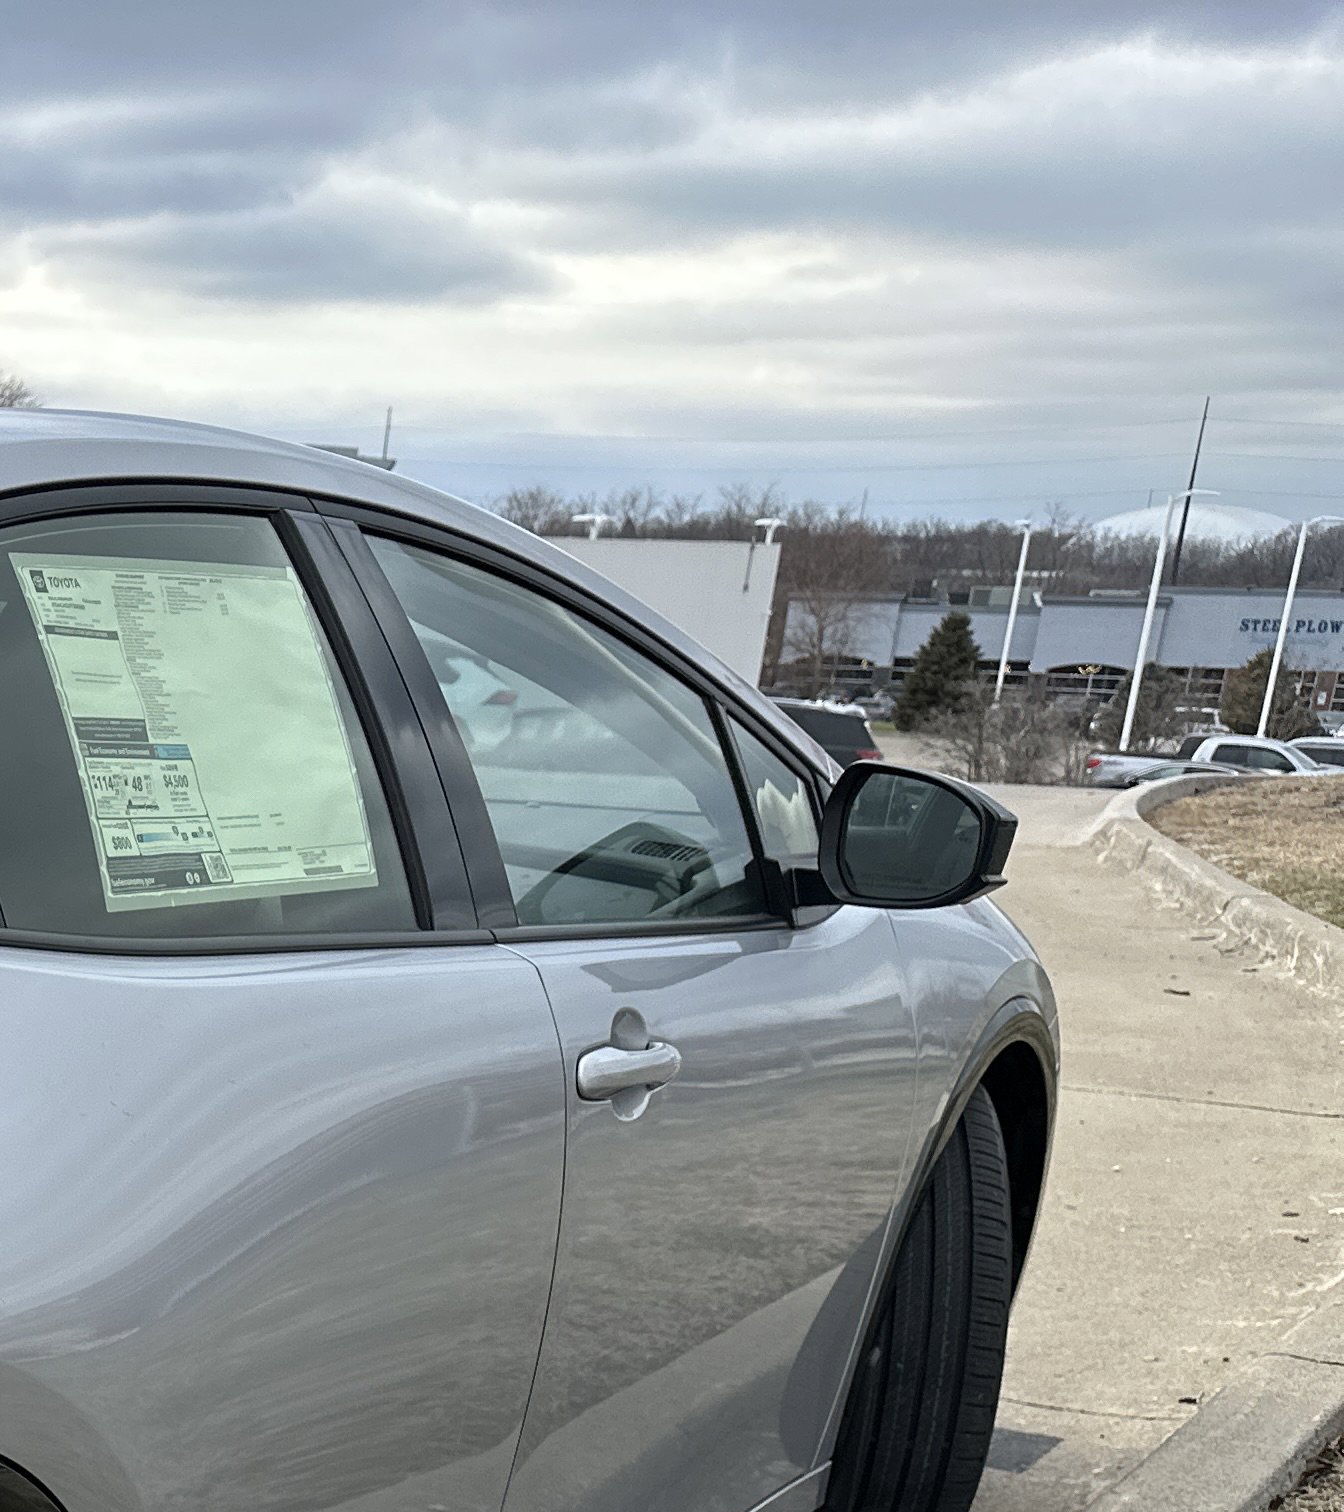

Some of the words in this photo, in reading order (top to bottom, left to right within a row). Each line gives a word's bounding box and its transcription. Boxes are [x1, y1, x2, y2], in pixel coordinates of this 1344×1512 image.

[47, 577, 82, 589] TOYOTA
[1239, 618, 1290, 633] STEE
[1295, 618, 1344, 633] PLOW
[96, 776, 114, 792] 114
[132, 776, 143, 792] 48
